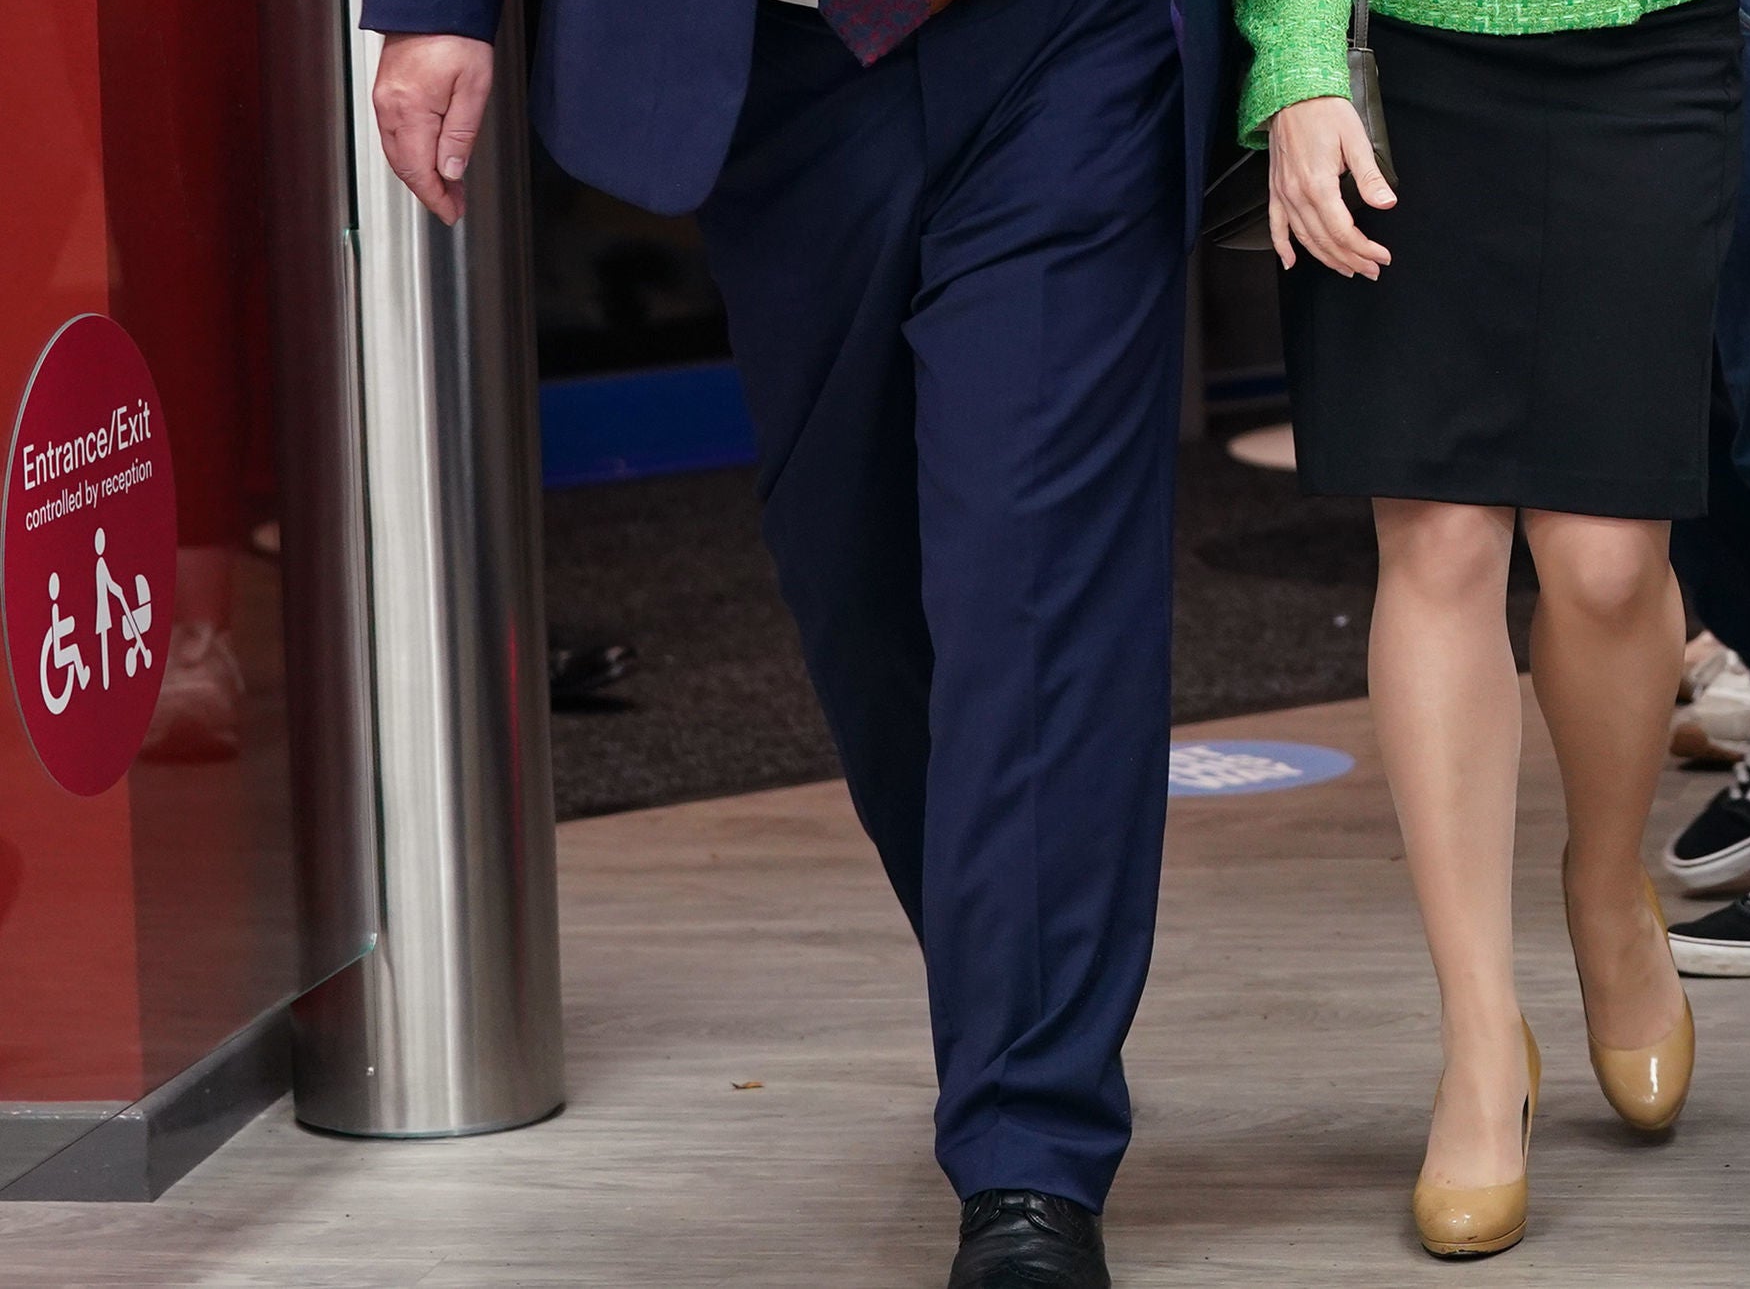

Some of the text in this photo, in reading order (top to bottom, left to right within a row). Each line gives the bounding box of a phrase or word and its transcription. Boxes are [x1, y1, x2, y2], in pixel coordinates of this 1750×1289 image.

[23, 398, 151, 490] Entrance/Exit
[25, 458, 152, 531] controlled by reception
